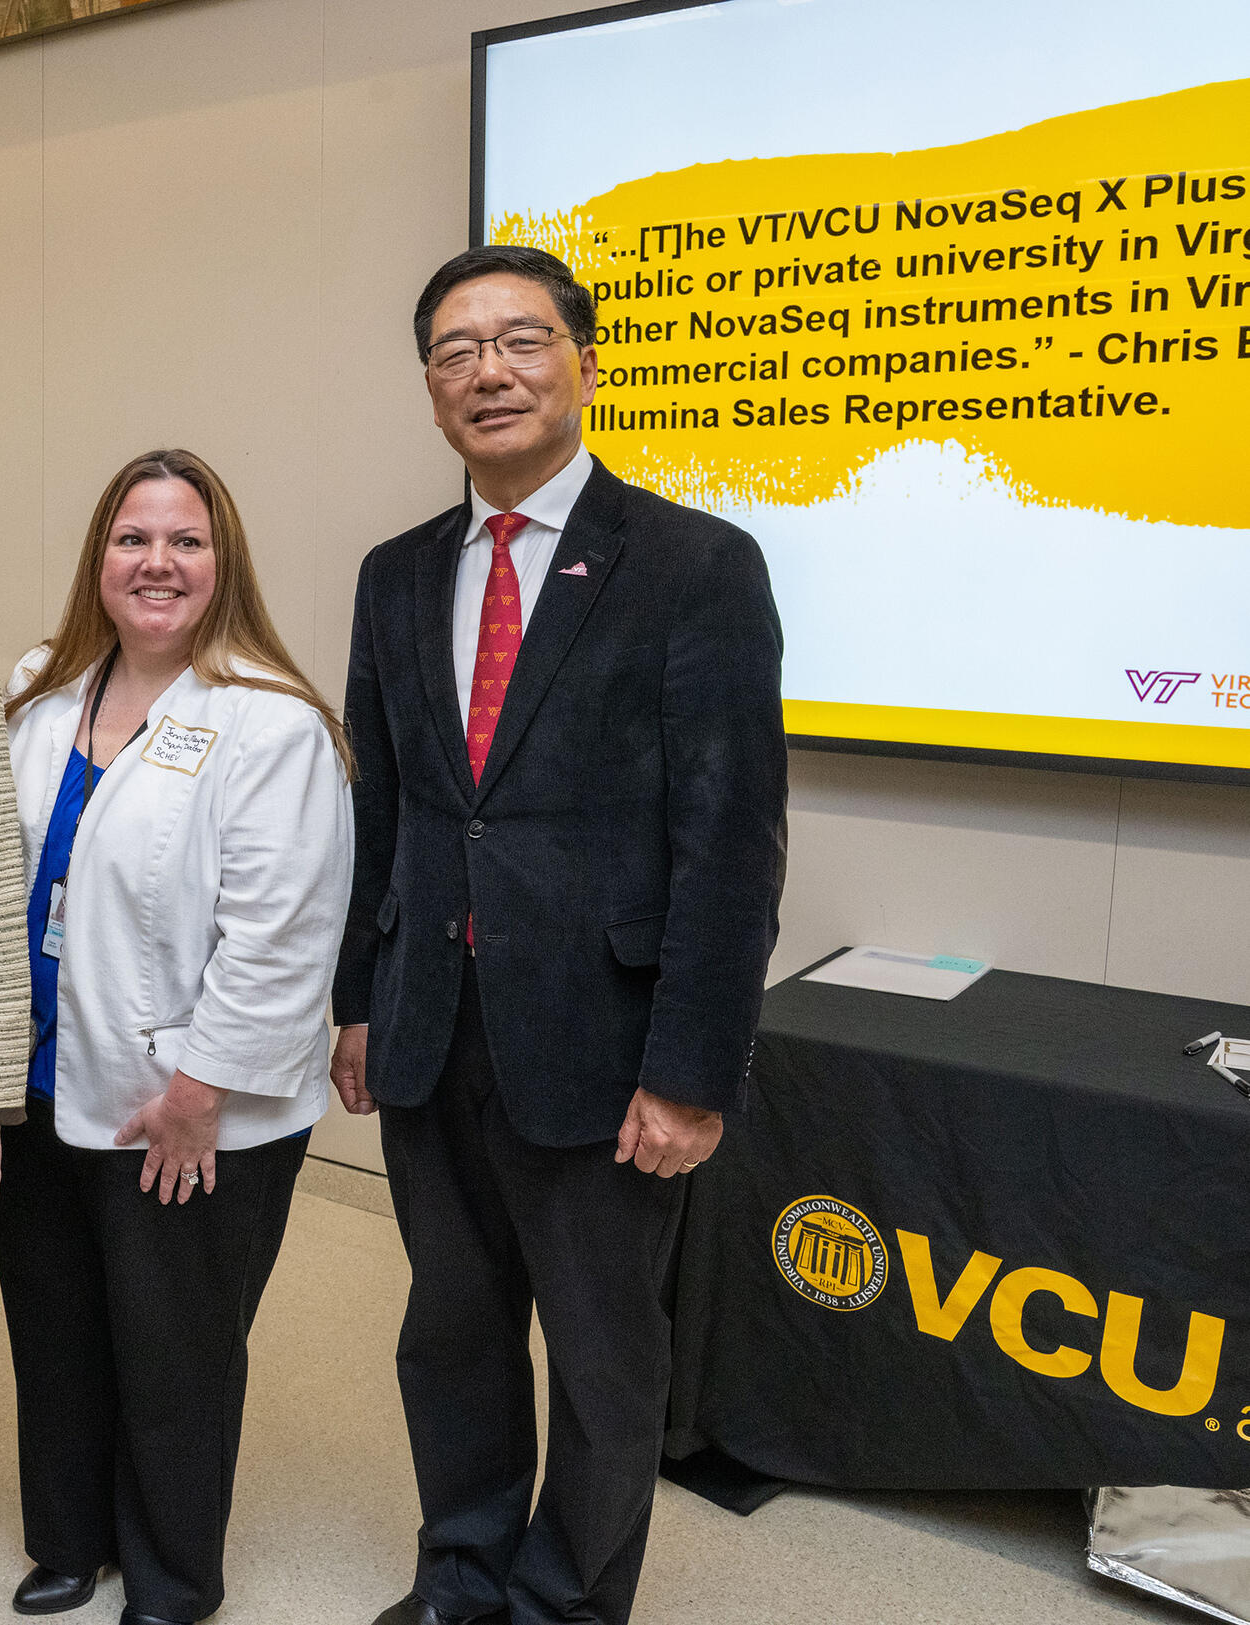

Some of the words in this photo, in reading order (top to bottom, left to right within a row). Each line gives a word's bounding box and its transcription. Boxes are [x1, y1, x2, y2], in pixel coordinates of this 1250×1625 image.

[738, 203, 881, 245] VT/VCU
[895, 189, 1081, 231] NovaSeq
[1095, 177, 1127, 213] X
[1143, 172, 1246, 208] Plus
[593, 268, 694, 301] public
[706, 269, 743, 292] or
[754, 255, 881, 297] private
[896, 235, 1104, 278] university
[1120, 228, 1158, 262] in
[594, 316, 678, 346] other
[689, 304, 850, 340] NovaSeq
[864, 286, 1113, 330] instruments
[1130, 280, 1169, 313] in
[596, 350, 788, 388] commercial
[1097, 328, 1218, 365] Chris
[590, 402, 719, 432] Illumina
[732, 397, 830, 427] Sales
[845, 384, 1170, 431] Representative.
[1124, 669, 1202, 704] VT
[1211, 673, 1250, 690] VIR
[781, 1200, 877, 1243] COMMONWEALTH
[821, 1216, 846, 1231] MCV
[777, 1234, 805, 1290] VIRGINIA
[818, 1278, 837, 1291] RPI
[847, 1245, 885, 1308] UNIVERSITY
[813, 1290, 839, 1307] 1838
[895, 1228, 1226, 1417] VCU
